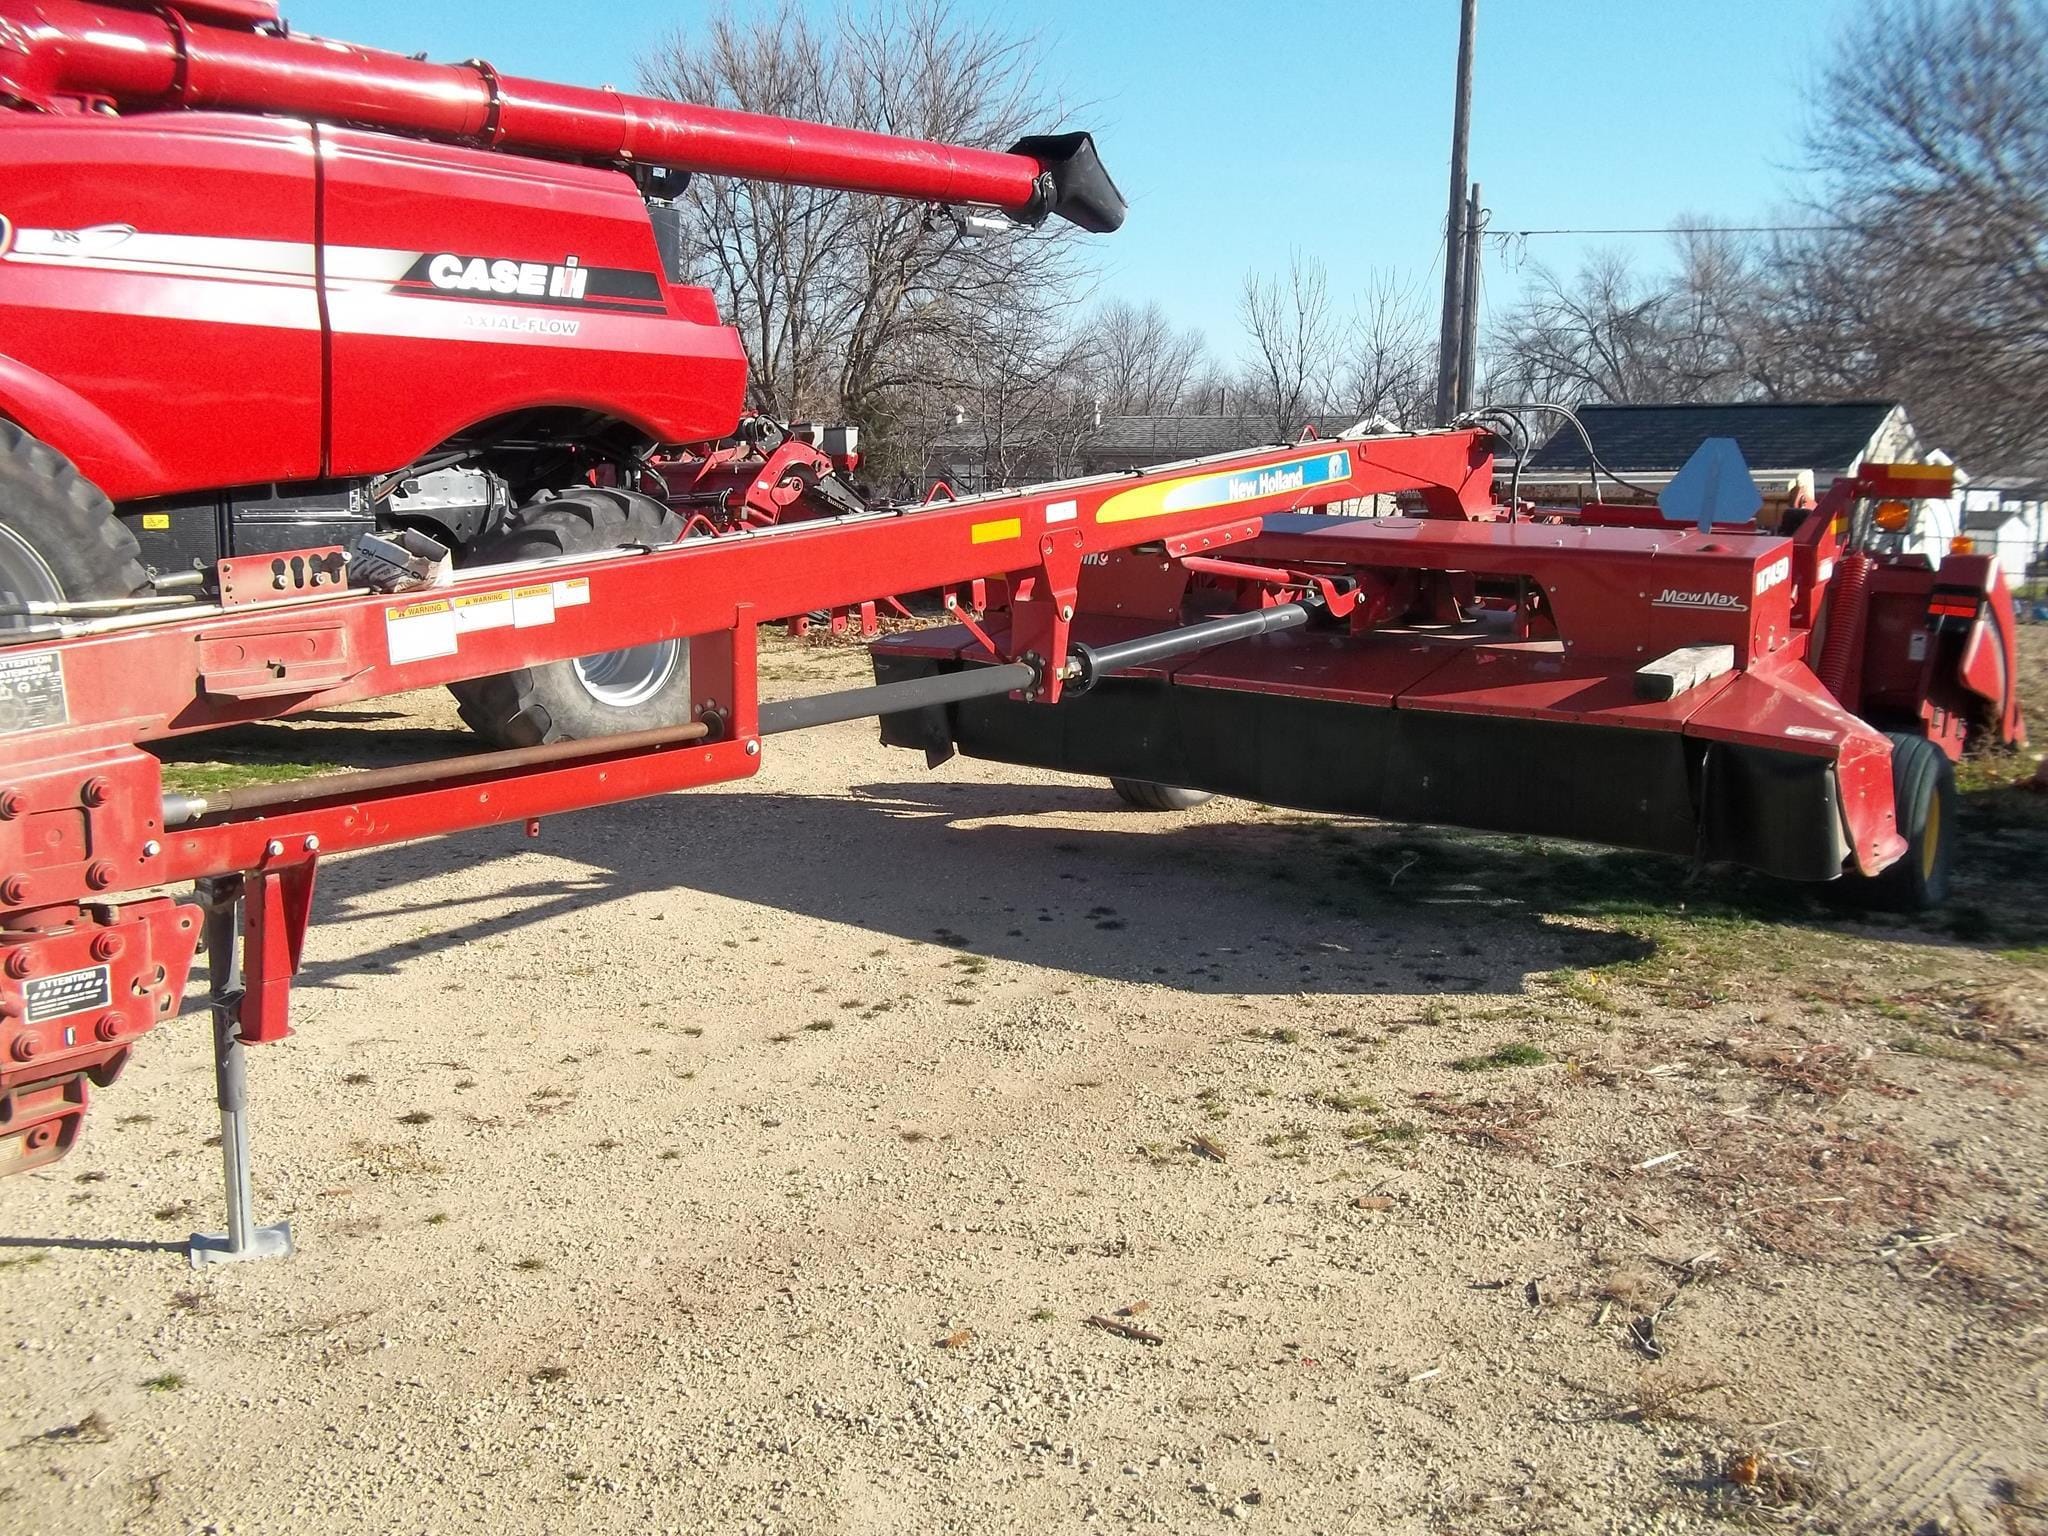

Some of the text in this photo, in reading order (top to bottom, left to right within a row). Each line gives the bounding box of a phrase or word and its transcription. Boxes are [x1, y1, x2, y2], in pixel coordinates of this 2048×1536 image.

[429, 254, 548, 296] CASE
[464, 315, 578, 335] AXIAL-FLOW
[1229, 465, 1304, 500] New Holland
[472, 592, 504, 605] WARNING
[523, 586, 549, 597] WARNING
[1660, 589, 1740, 607] Mow Max
[408, 603, 443, 616] WARNING
[38, 970, 97, 990] ATTENTION
